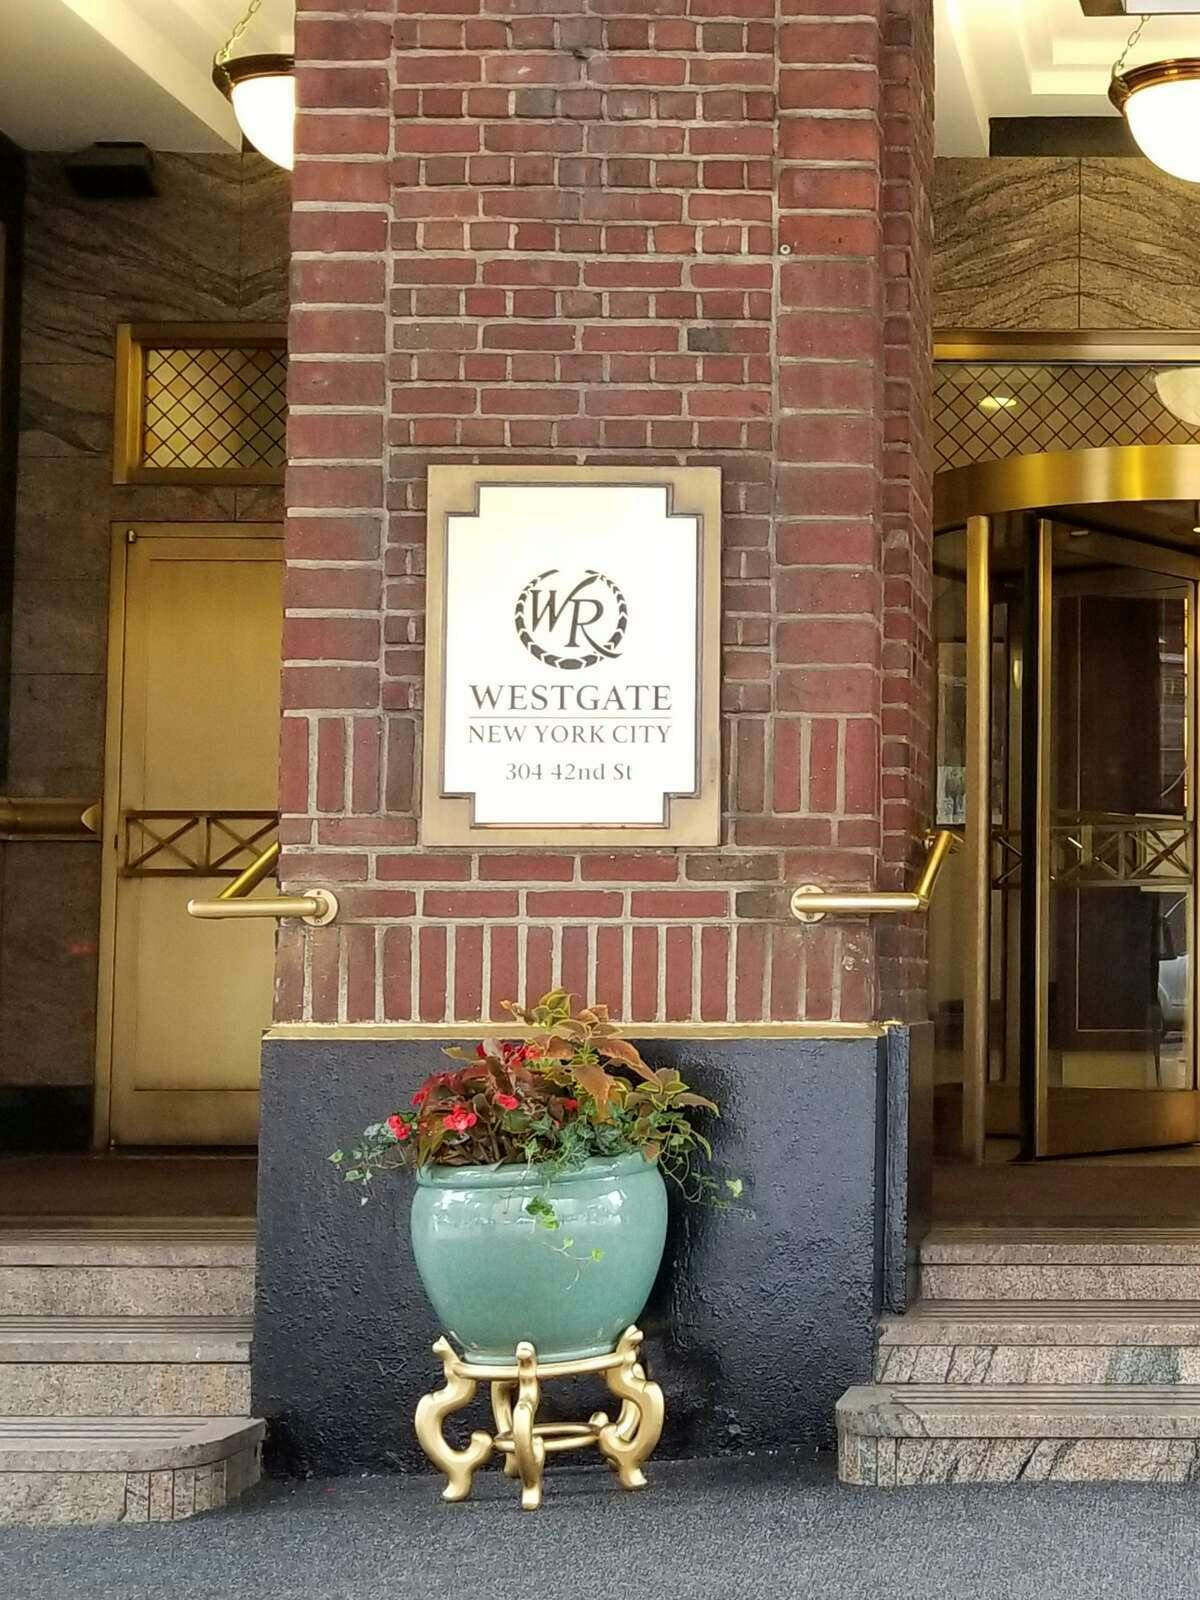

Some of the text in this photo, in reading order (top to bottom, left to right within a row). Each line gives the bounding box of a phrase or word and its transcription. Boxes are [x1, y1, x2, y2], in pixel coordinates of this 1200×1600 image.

[530, 573, 624, 659] WR
[468, 684, 673, 711] WESTGATE
[468, 724, 672, 744] NEW YORK CITY
[505, 762, 633, 781] 304 42nd St
